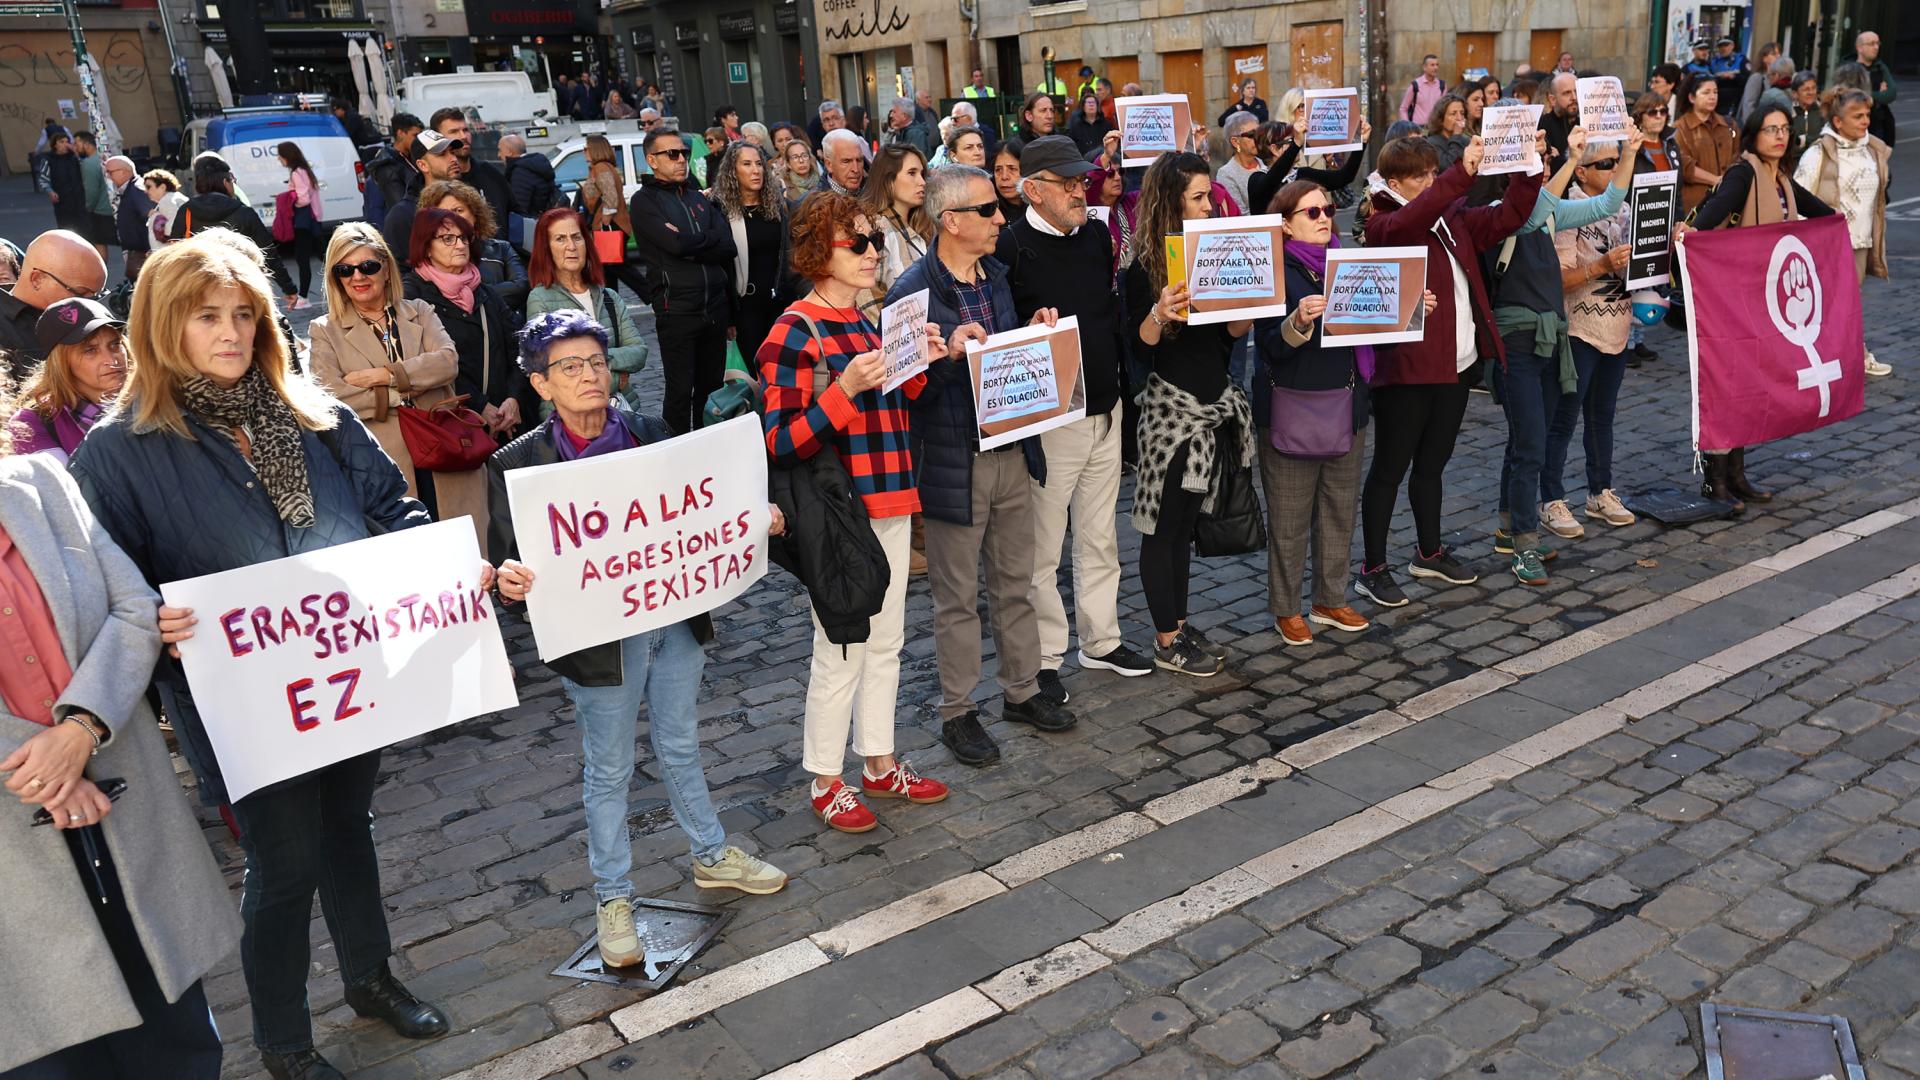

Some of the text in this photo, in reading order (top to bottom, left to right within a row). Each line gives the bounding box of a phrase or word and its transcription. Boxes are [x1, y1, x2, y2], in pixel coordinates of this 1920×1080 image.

[424, 14, 437, 28] 2
[826, 0, 910, 41] nails
[1484, 135, 1524, 146] BORTXAKETA
[1484, 155, 1490, 164] ES
[1639, 200, 1669, 212] LA VIOLENCIA
[1641, 218, 1666, 228] MACHISTA
[1638, 234, 1666, 246] QUE NO CESA
[1196, 257, 1270, 268] BORTXAKETA DA.
[1198, 274, 1264, 286] ES VIOLACIÓN!
[1333, 286, 1397, 295] BORTXAKETA DA.
[1334, 303, 1343, 312] ES
[886, 366, 892, 378] ES
[983, 368, 1052, 390] BORTXAKETA DA.
[987, 388, 1048, 409] ES VIOLACIÓN!
[623, 498, 649, 533] A
[659, 476, 714, 523] LAS
[219, 590, 350, 657] ERASO
